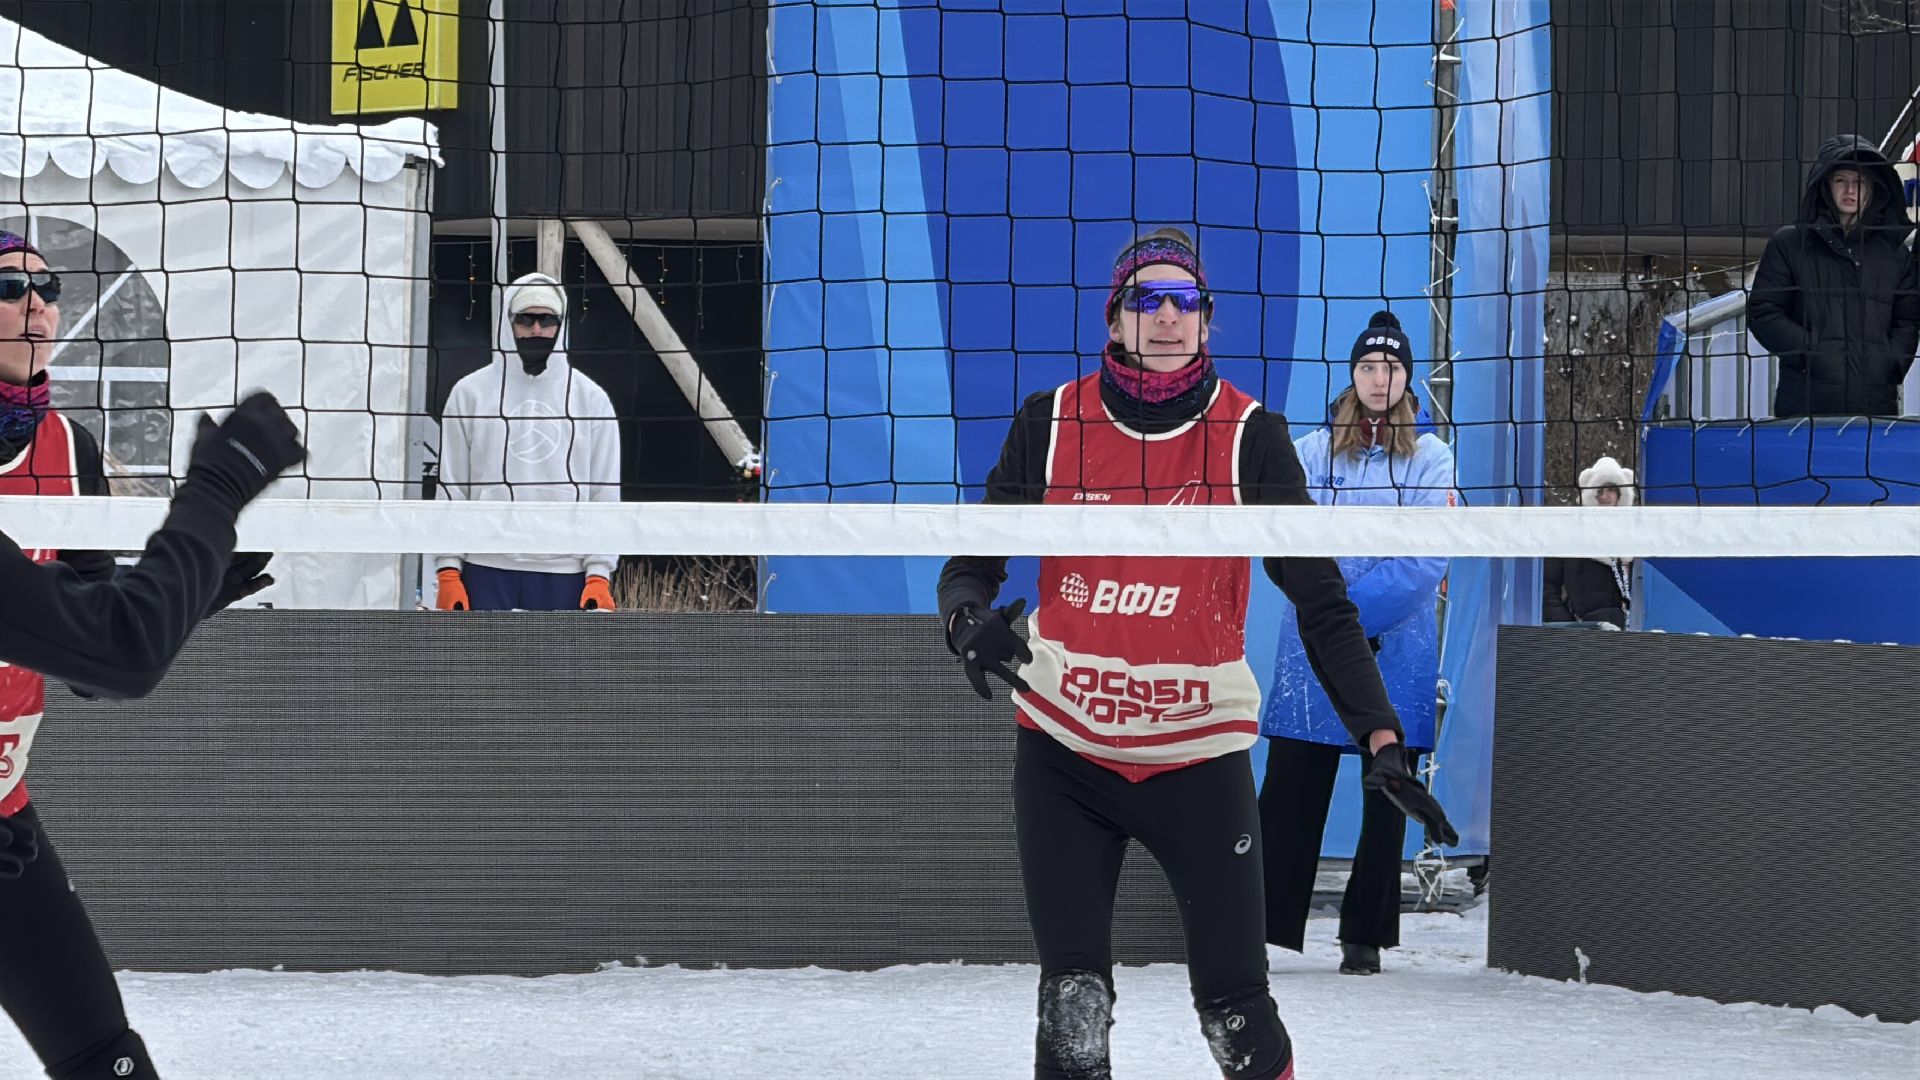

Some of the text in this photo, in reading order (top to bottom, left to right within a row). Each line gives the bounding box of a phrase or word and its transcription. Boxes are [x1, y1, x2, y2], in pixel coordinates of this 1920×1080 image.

[342, 62, 426, 82] FISCHER
[1089, 579, 1181, 616] ВФВ
[1064, 660, 1210, 704] ОСОБЛ
